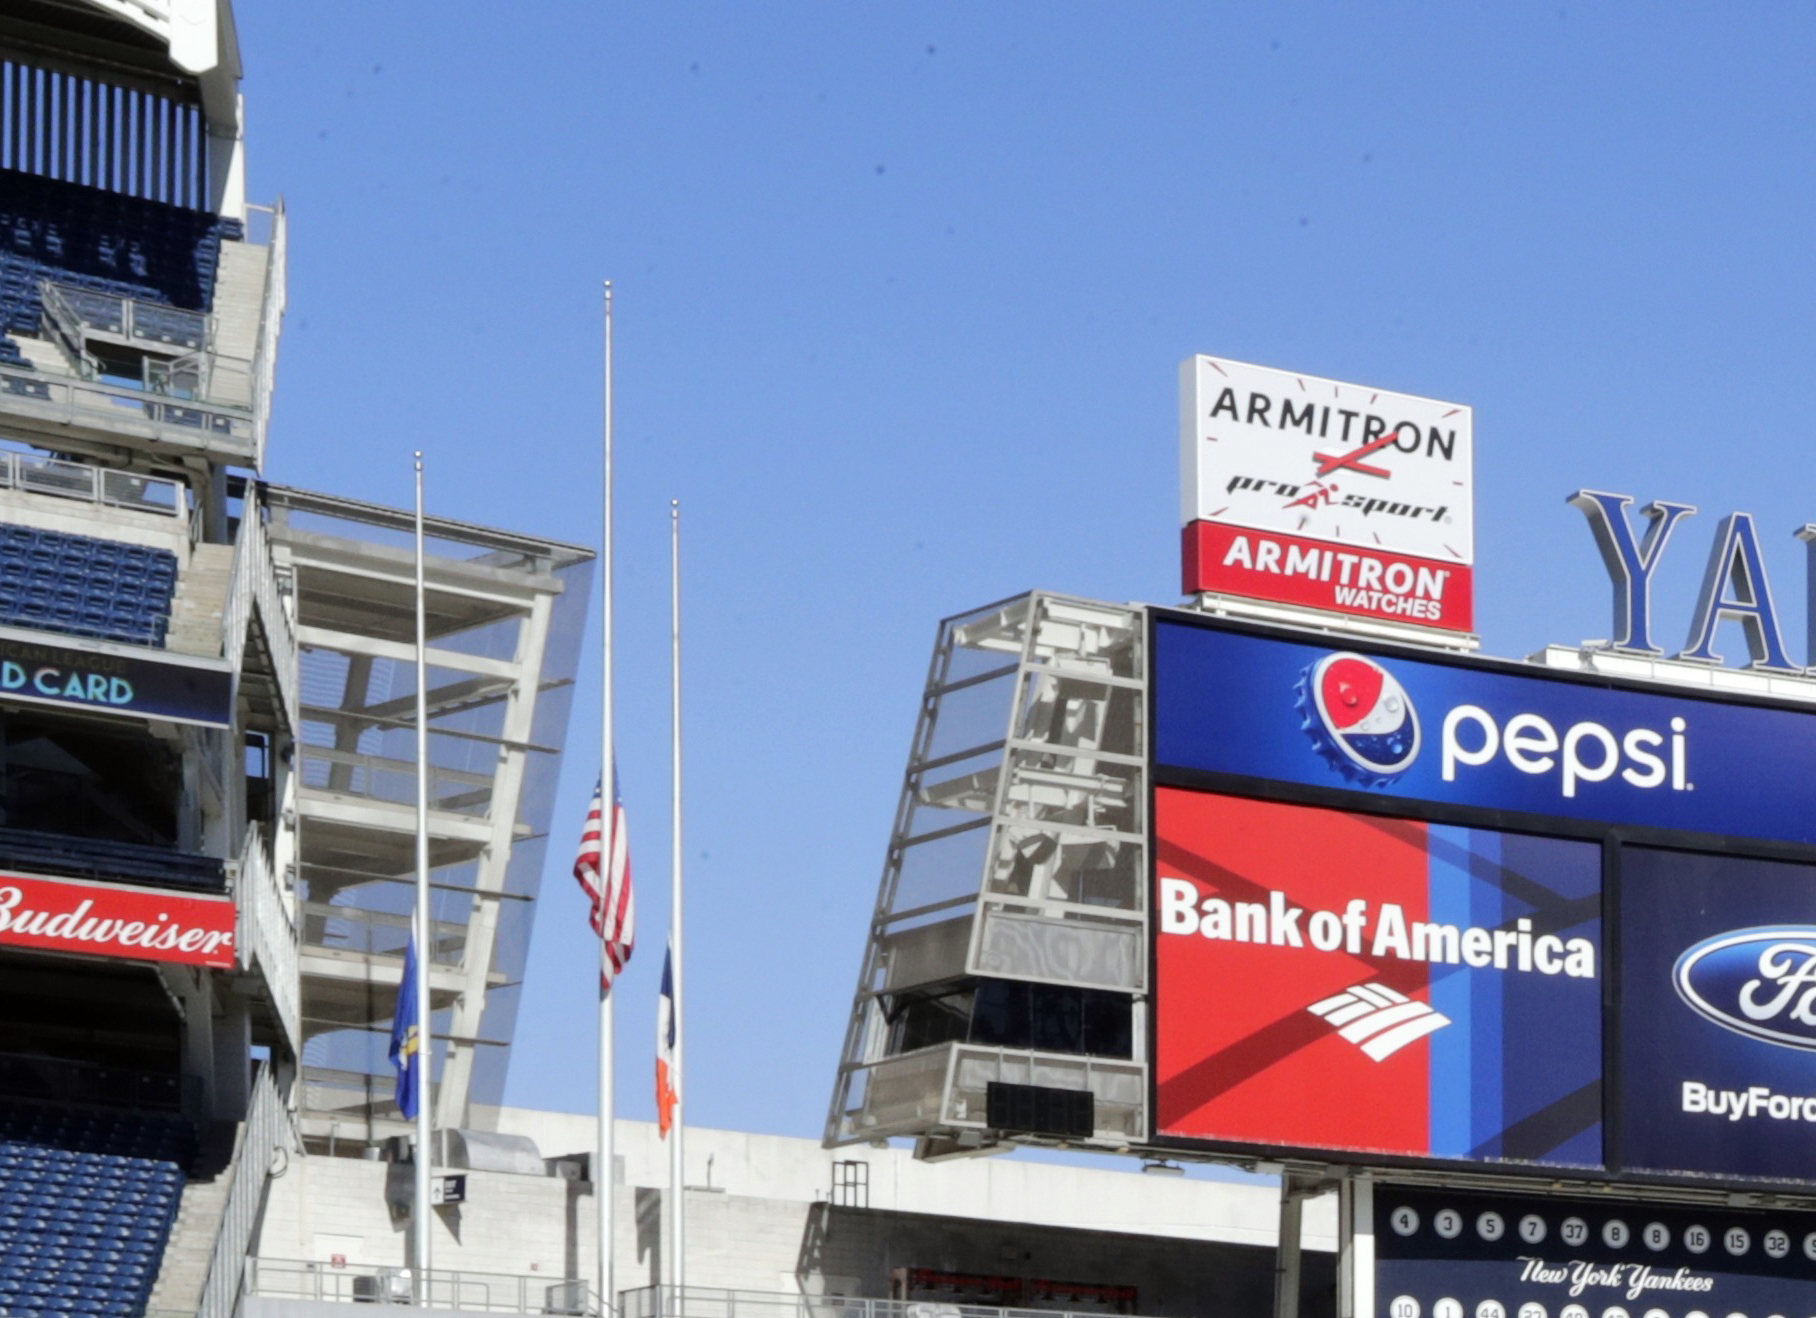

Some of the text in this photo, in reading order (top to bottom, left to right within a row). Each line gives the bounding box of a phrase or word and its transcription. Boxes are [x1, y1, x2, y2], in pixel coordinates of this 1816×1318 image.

[1209, 386, 1457, 461] ARMITRON
[1225, 474, 1449, 524] pro sport
[1222, 535, 1446, 599] ARMITRON
[1335, 584, 1442, 621] WATCHES
[33, 666, 134, 705] CARD
[1442, 704, 1687, 797] pepsi
[1160, 878, 1595, 979] Bank of America
[1400, 1213, 1409, 1229] 4
[1443, 1216, 1453, 1231] 3
[1486, 1218, 1495, 1233] 5
[1528, 1221, 1537, 1236] 7
[1566, 1224, 1583, 1240] 37
[1611, 1227, 1620, 1242] 8
[1652, 1229, 1661, 1244] 8
[1690, 1231, 1705, 1247] 16
[1730, 1234, 1744, 1249] 15
[1768, 1236, 1785, 1251] 32
[1516, 1256, 1713, 1300] New York Yankees
[1398, 1303, 1412, 1318] 10
